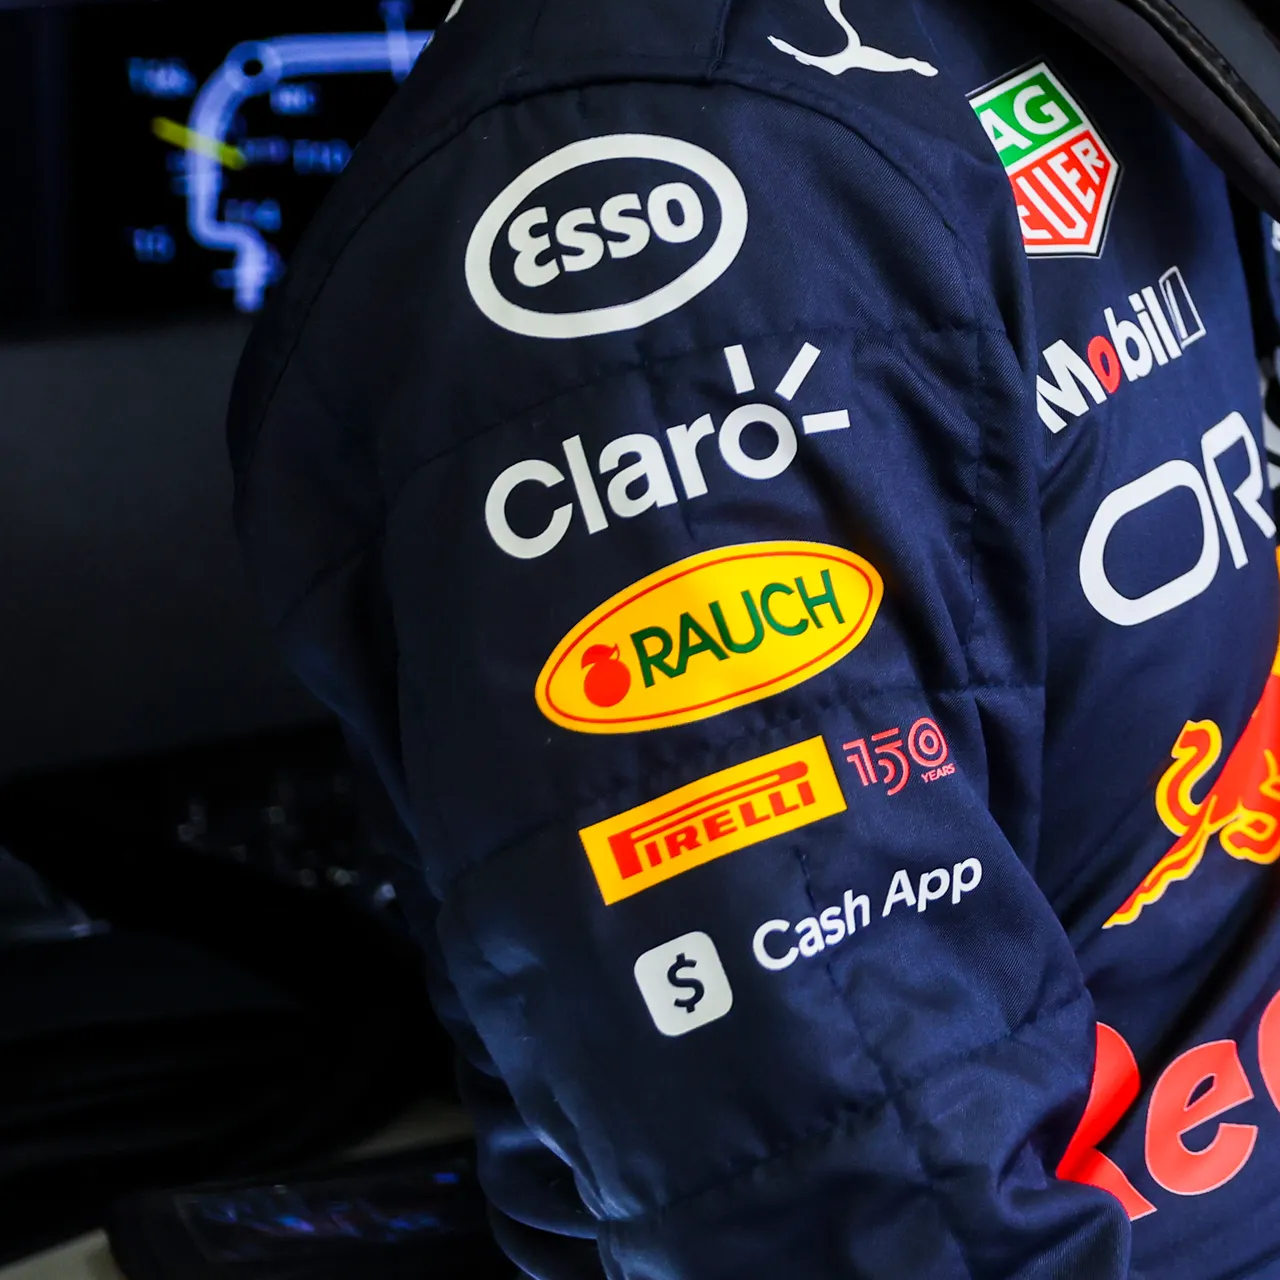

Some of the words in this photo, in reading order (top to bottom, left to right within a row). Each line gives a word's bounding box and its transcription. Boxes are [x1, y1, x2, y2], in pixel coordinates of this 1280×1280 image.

[979, 84, 1070, 152] AG
[1016, 137, 1104, 240] EUER
[1037, 286, 1183, 434] Mobil
[485, 403, 798, 560] Claro
[629, 568, 845, 689] RAUCH
[607, 760, 816, 880] PIRELLI
[921, 763, 956, 783] YEARS
[752, 891, 870, 971] Cash
[882, 857, 983, 917] App
